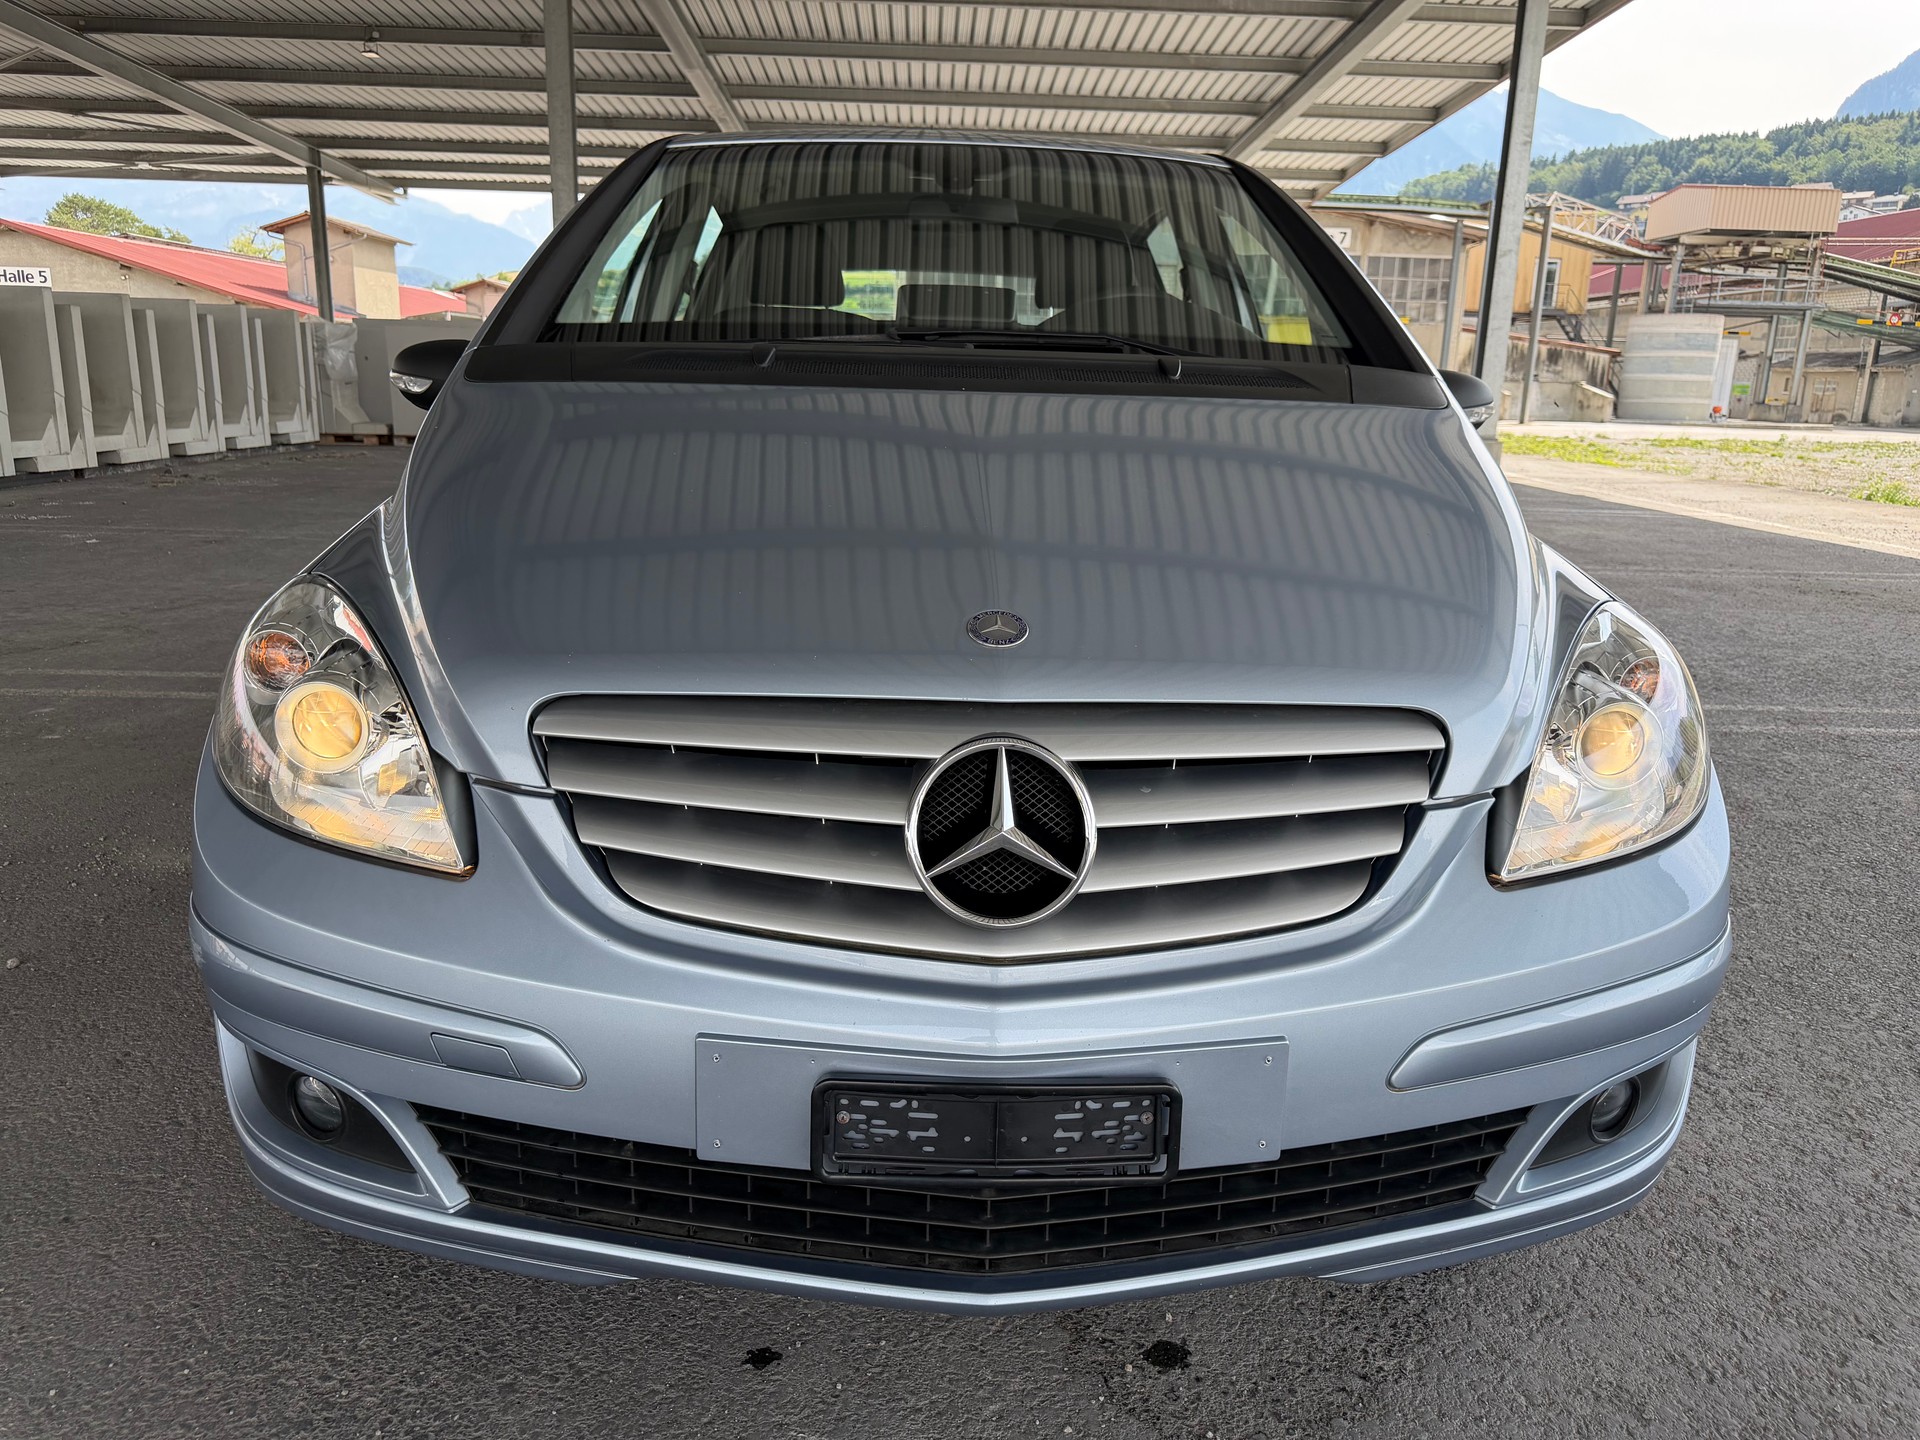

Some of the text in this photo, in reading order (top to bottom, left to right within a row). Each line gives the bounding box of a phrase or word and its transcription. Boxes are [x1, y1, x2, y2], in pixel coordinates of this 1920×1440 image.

[1339, 231, 1347, 245] 7
[0, 269, 48, 284] Halle 5
